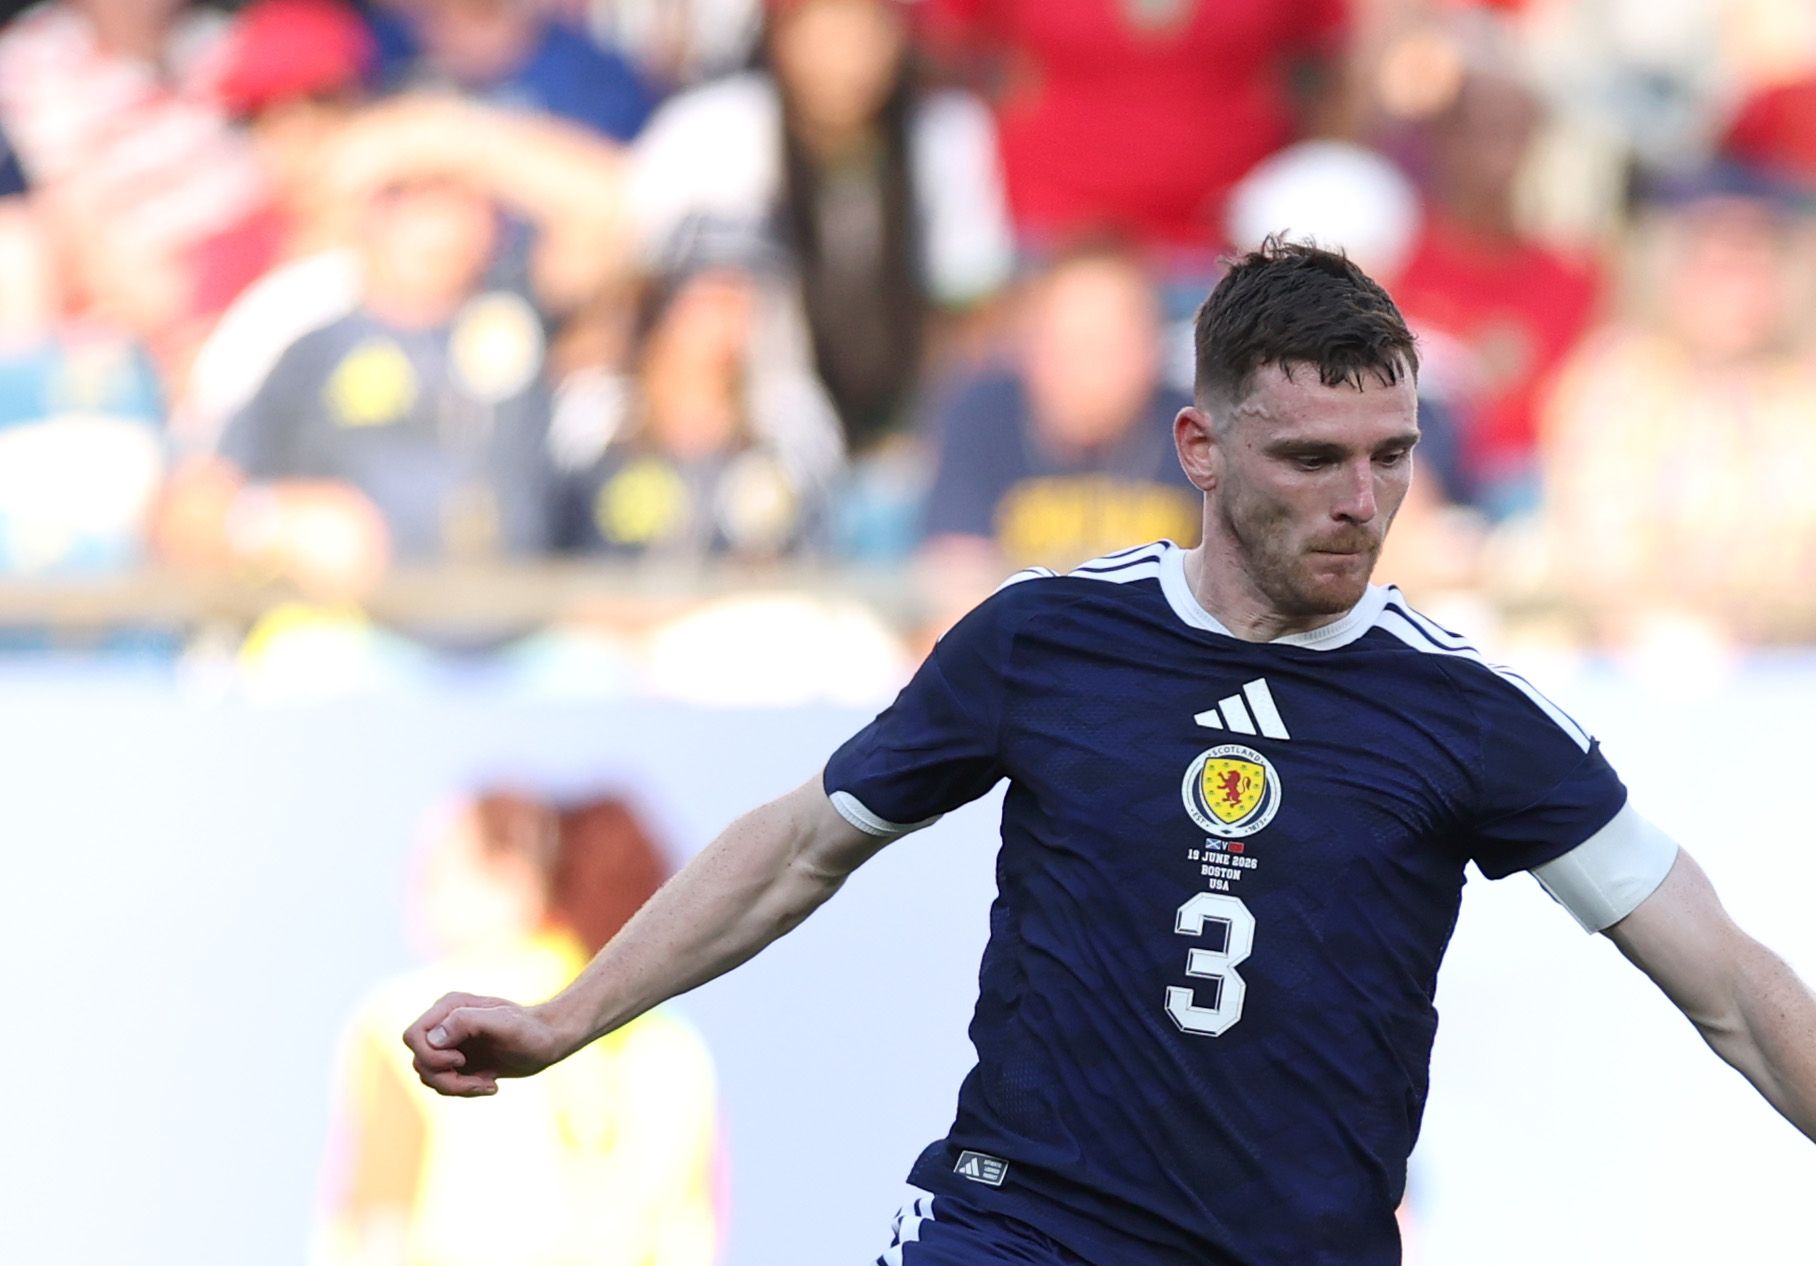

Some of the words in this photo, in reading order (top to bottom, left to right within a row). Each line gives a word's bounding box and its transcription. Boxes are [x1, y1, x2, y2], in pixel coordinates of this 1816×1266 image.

[1212, 746, 1261, 762] SCOTLAND
[1187, 848, 1200, 860] 19
[1201, 851, 1230, 865] JUNE
[1231, 855, 1258, 869] 2026
[1201, 864, 1241, 880] BOSTON
[1209, 878, 1229, 891] USA
[1164, 891, 1256, 1038] 3
